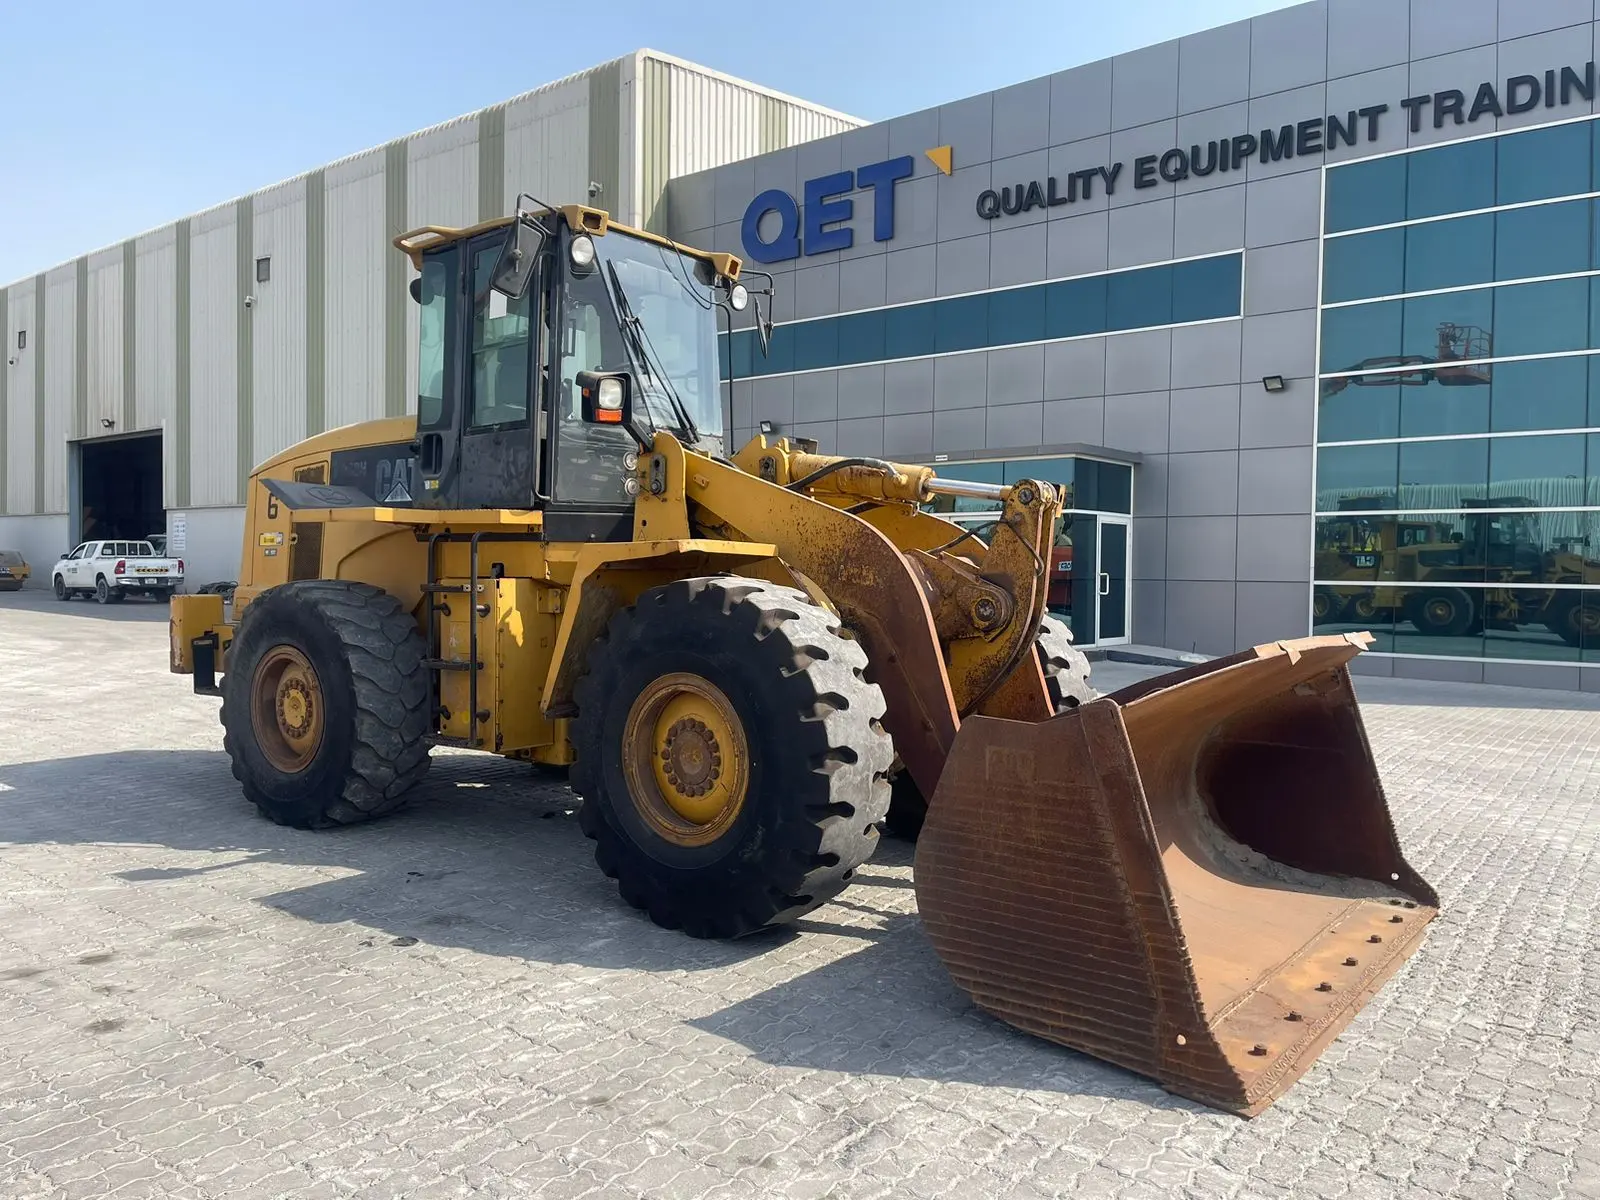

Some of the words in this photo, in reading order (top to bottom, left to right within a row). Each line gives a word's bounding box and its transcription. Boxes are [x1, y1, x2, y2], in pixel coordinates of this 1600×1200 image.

[976, 162, 1122, 220] QUALITY
[1134, 104, 1388, 190] EQUIPMENT
[1402, 61, 1600, 133] TRADIN
[741, 155, 913, 264] QET
